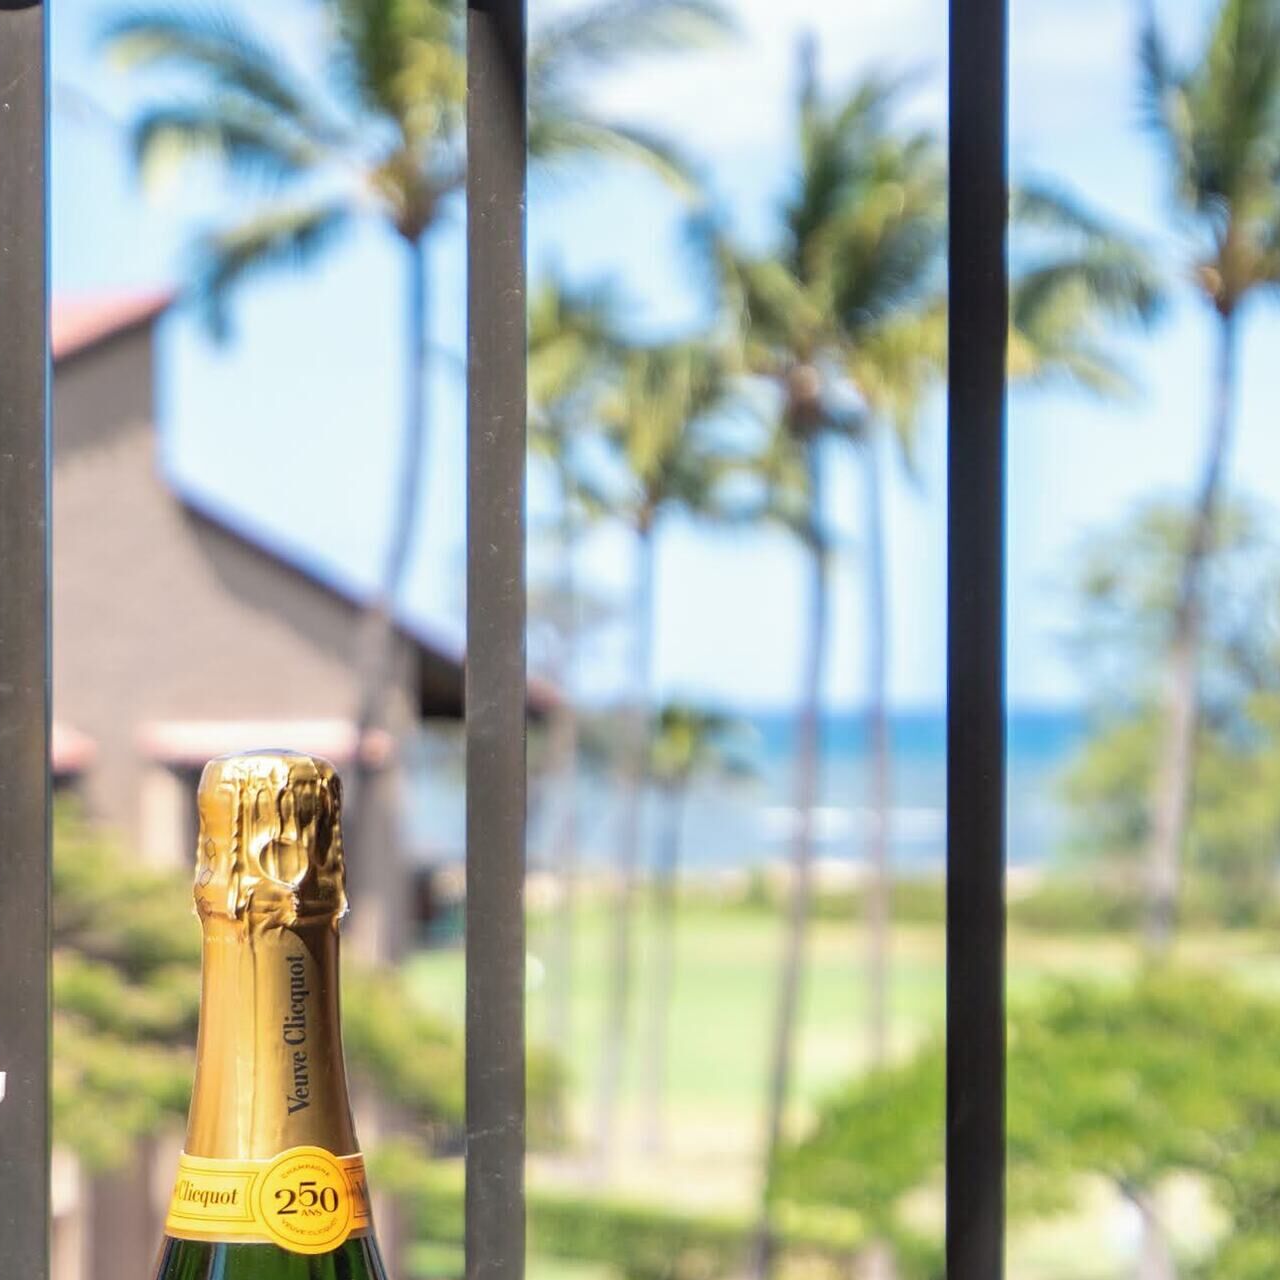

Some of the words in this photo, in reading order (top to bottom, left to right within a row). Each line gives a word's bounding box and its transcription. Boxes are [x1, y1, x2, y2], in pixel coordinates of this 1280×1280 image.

[282, 954, 311, 1044] Clicquot
[287, 1051, 312, 1117] Veuve
[177, 1179, 239, 1208] Clicquot
[274, 1181, 339, 1215] 250
[301, 1209, 322, 1217] ANS
